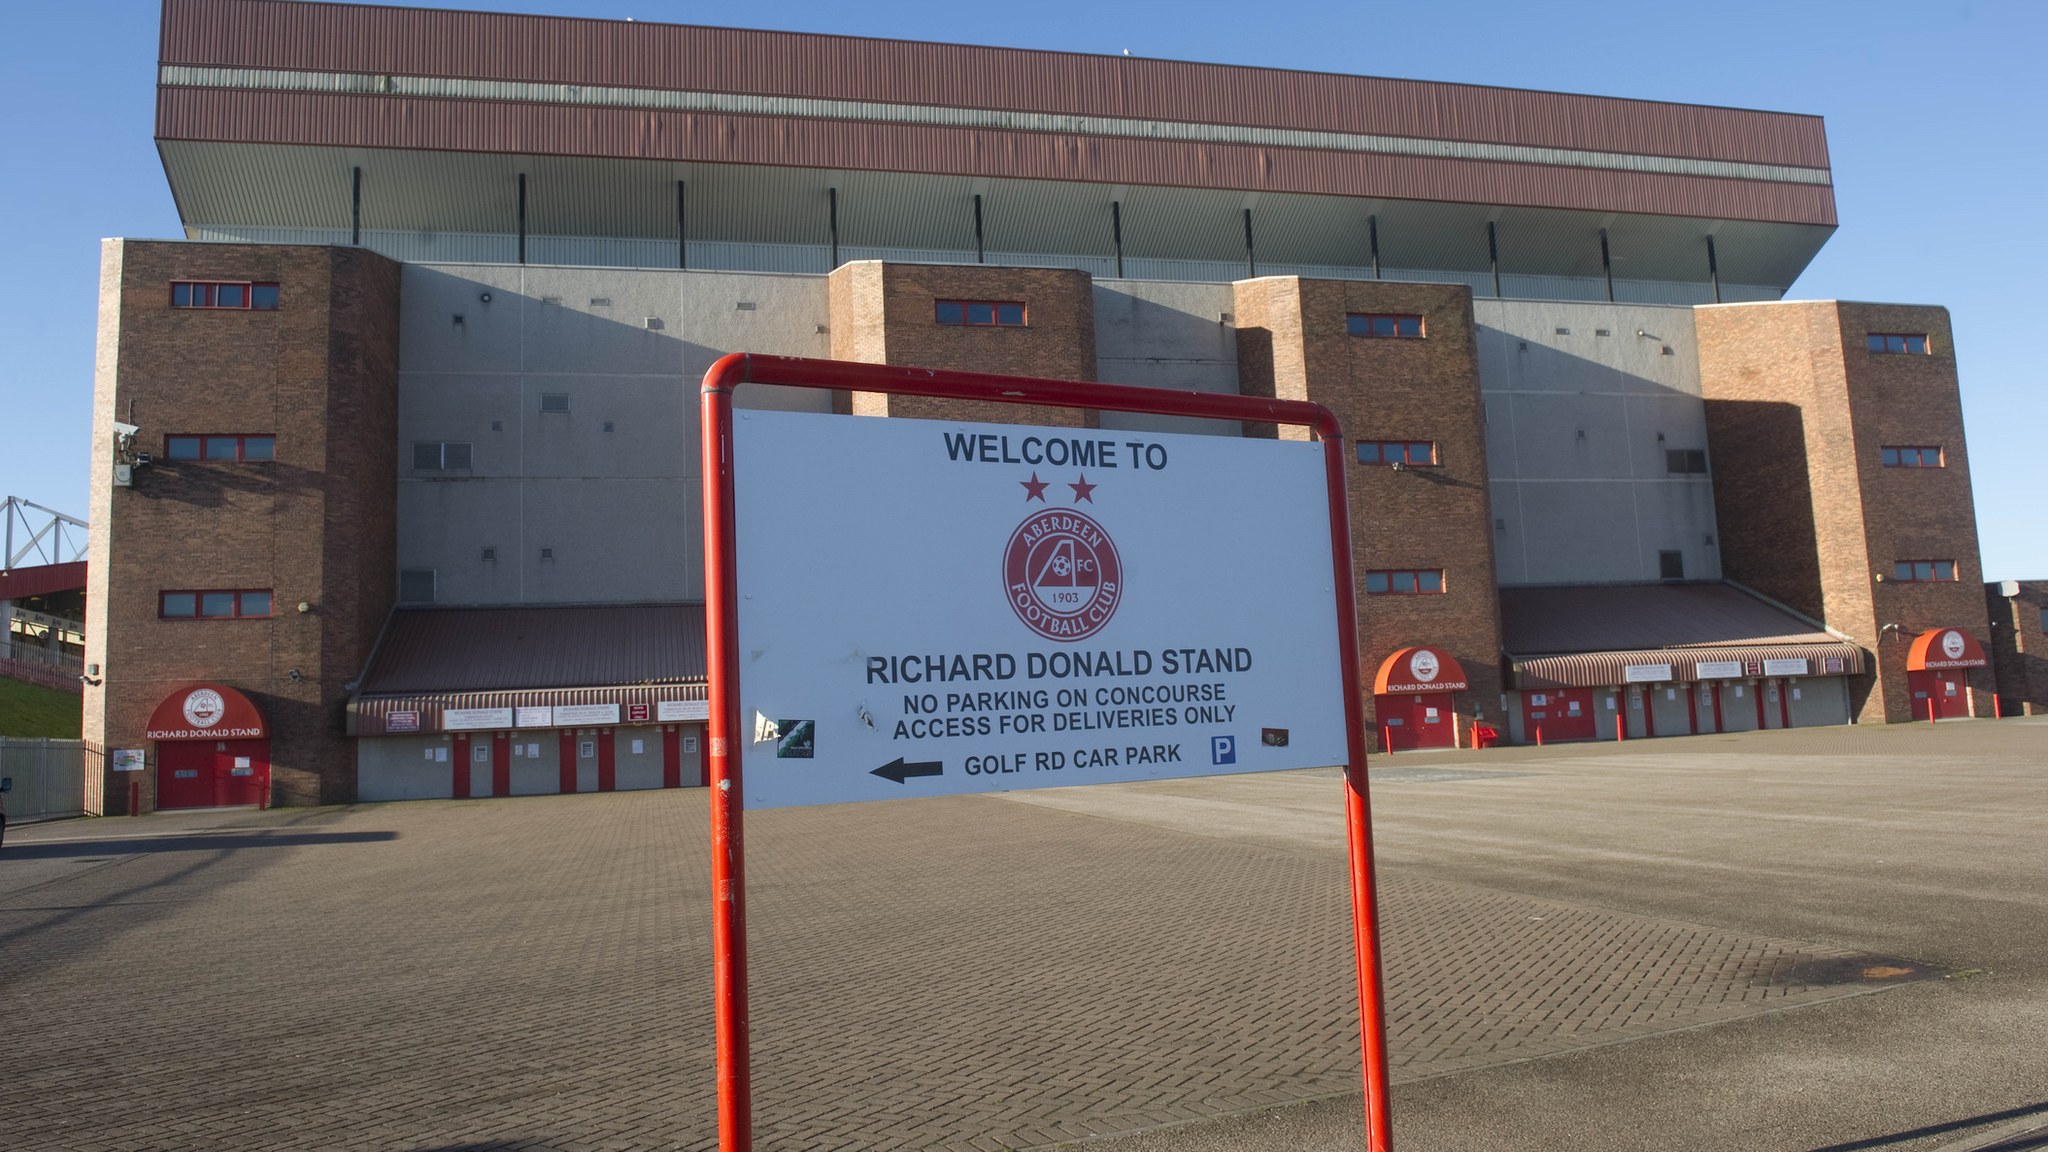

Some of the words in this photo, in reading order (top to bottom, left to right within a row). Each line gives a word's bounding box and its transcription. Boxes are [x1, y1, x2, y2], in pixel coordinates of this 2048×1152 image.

[944, 433, 1118, 469] WELCOME
[1126, 442, 1168, 470] TO
[1022, 516, 1103, 548] ABERDEEN
[1011, 582, 1089, 635] FOOTBALL
[1089, 581, 1116, 622] CLUB
[1052, 592, 1079, 604] 1903
[866, 655, 1017, 684] RICHARD
[1027, 650, 1153, 679] DONALD
[1162, 647, 1253, 674] STAND
[190, 690, 218, 701] ABERDEEN
[903, 693, 938, 715] NO
[947, 689, 1049, 712] PARKING
[1056, 686, 1088, 708] ON
[1095, 683, 1227, 707] CONCOURSE
[1388, 683, 1416, 692] RICHARD
[1417, 682, 1444, 690] DONALD
[147, 730, 188, 739] RICHARD
[190, 729, 229, 738] DONALD
[231, 728, 261, 737] STAND
[893, 715, 993, 740] ACCESS
[1000, 711, 1047, 734] FOR
[1053, 707, 1178, 732] DELIVERIES
[1184, 705, 1236, 726] ONLY
[964, 754, 1031, 776] GOLF
[1037, 751, 1067, 773] RD
[1073, 748, 1119, 770] CAR
[1125, 744, 1182, 767] PARK
[1215, 738, 1231, 763] P
